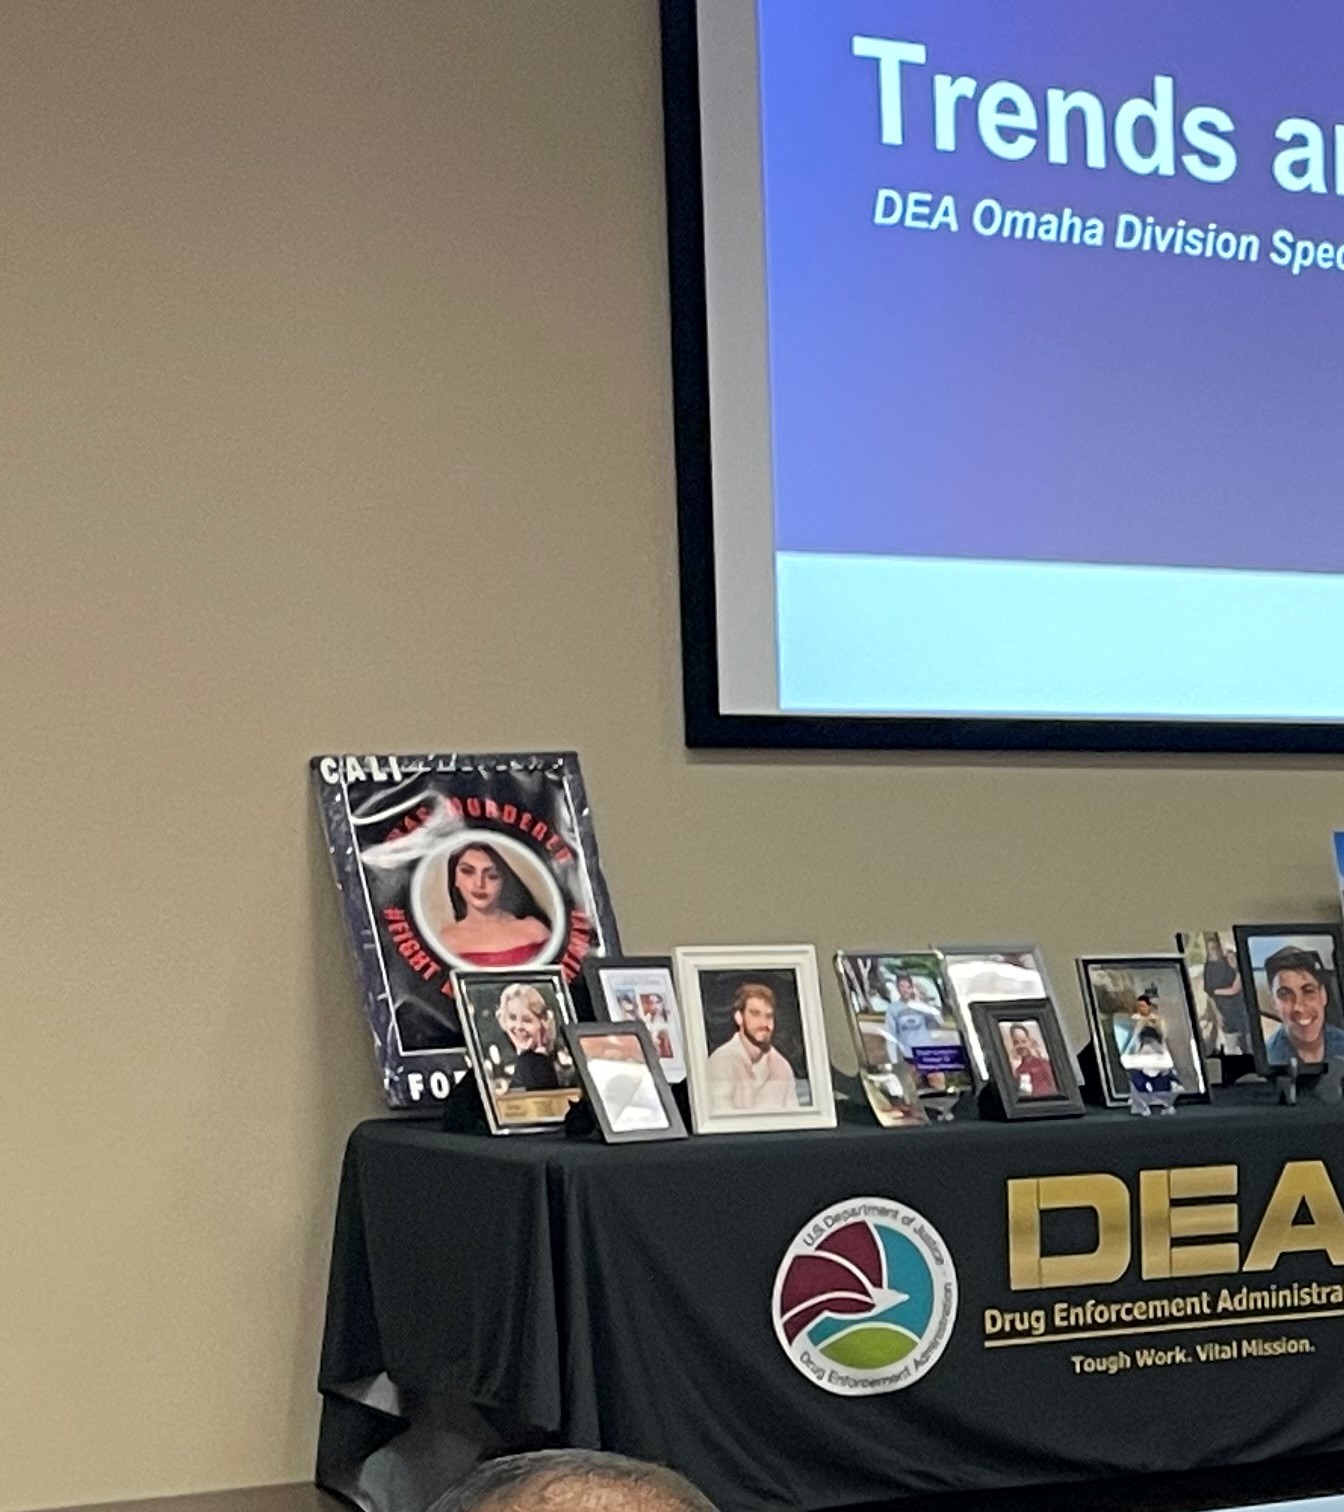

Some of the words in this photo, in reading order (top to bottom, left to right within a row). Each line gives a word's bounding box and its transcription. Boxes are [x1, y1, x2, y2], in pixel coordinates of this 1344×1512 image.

[852, 35, 1238, 182] Trends
[873, 188, 959, 232] DEA
[972, 198, 1104, 246] Omaha
[1115, 213, 1260, 263] Division
[319, 754, 402, 784] CALI
[983, 1307, 1046, 1337] Drug
[1053, 1293, 1212, 1328] Enforcement
[1071, 1352, 1131, 1376] Tough
[1135, 1347, 1193, 1368] Work.
[1196, 1342, 1238, 1362] Vital
[1241, 1336, 1317, 1358] Mission.
